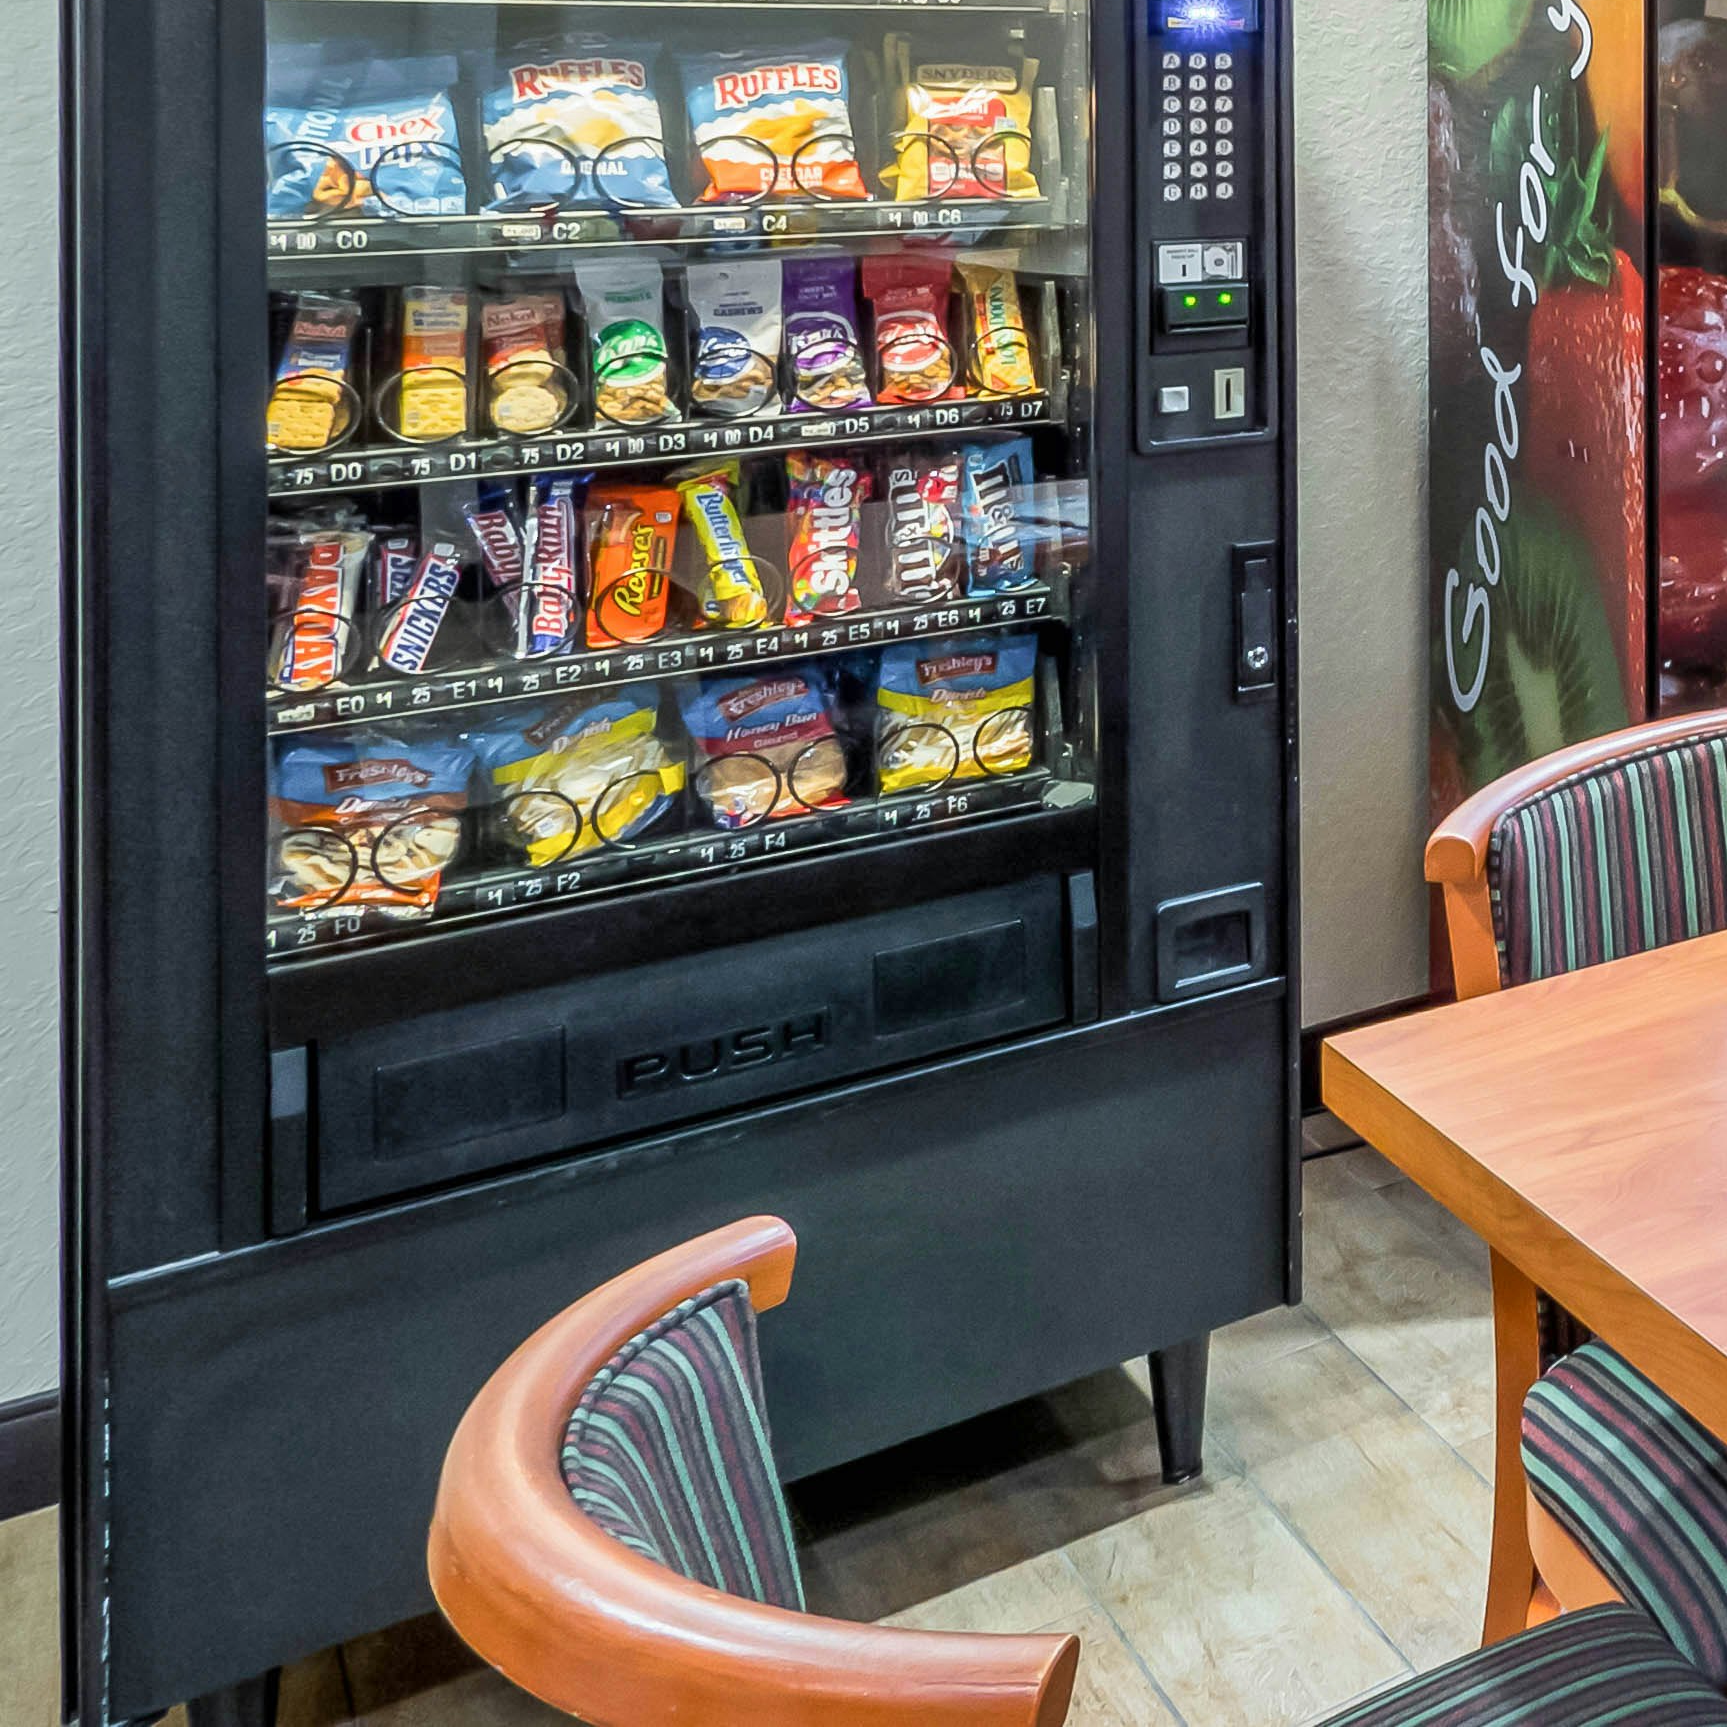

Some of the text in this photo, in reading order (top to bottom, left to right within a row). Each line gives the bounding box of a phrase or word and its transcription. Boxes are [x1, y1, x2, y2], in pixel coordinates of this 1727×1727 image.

[513, 59, 647, 101] RUFFLES
[716, 65, 840, 108] RUFFLES
[350, 110, 440, 143] Chex
[560, 158, 628, 177] OIGNAL
[1494, 85, 1556, 307] for
[762, 214, 789, 232] C4
[938, 208, 963, 225] C6
[336, 230, 368, 249] C0
[552, 221, 582, 240] C2
[935, 407, 960, 426] D6
[1020, 400, 1043, 418] D7
[748, 423, 775, 442] D4
[845, 416, 870, 435] D5
[658, 432, 686, 451] D3
[449, 451, 478, 470] D1
[556, 442, 585, 461] D2
[331, 463, 362, 482] D0
[810, 467, 858, 598] Skittles
[1445, 345, 1522, 714] Good
[612, 523, 655, 616] Reese's
[1025, 597, 1046, 615] E7
[391, 559, 460, 673] SNICKERS
[938, 608, 960, 627] E6
[848, 623, 871, 641] E5
[756, 635, 780, 654] E4
[658, 649, 683, 668] E3
[556, 664, 582, 684] E2
[452, 680, 478, 699] E1
[337, 695, 366, 716] E0
[946, 794, 969, 813] F6
[764, 832, 786, 850] F4
[556, 872, 582, 891] F2
[617, 1012, 831, 1100] PUSH
